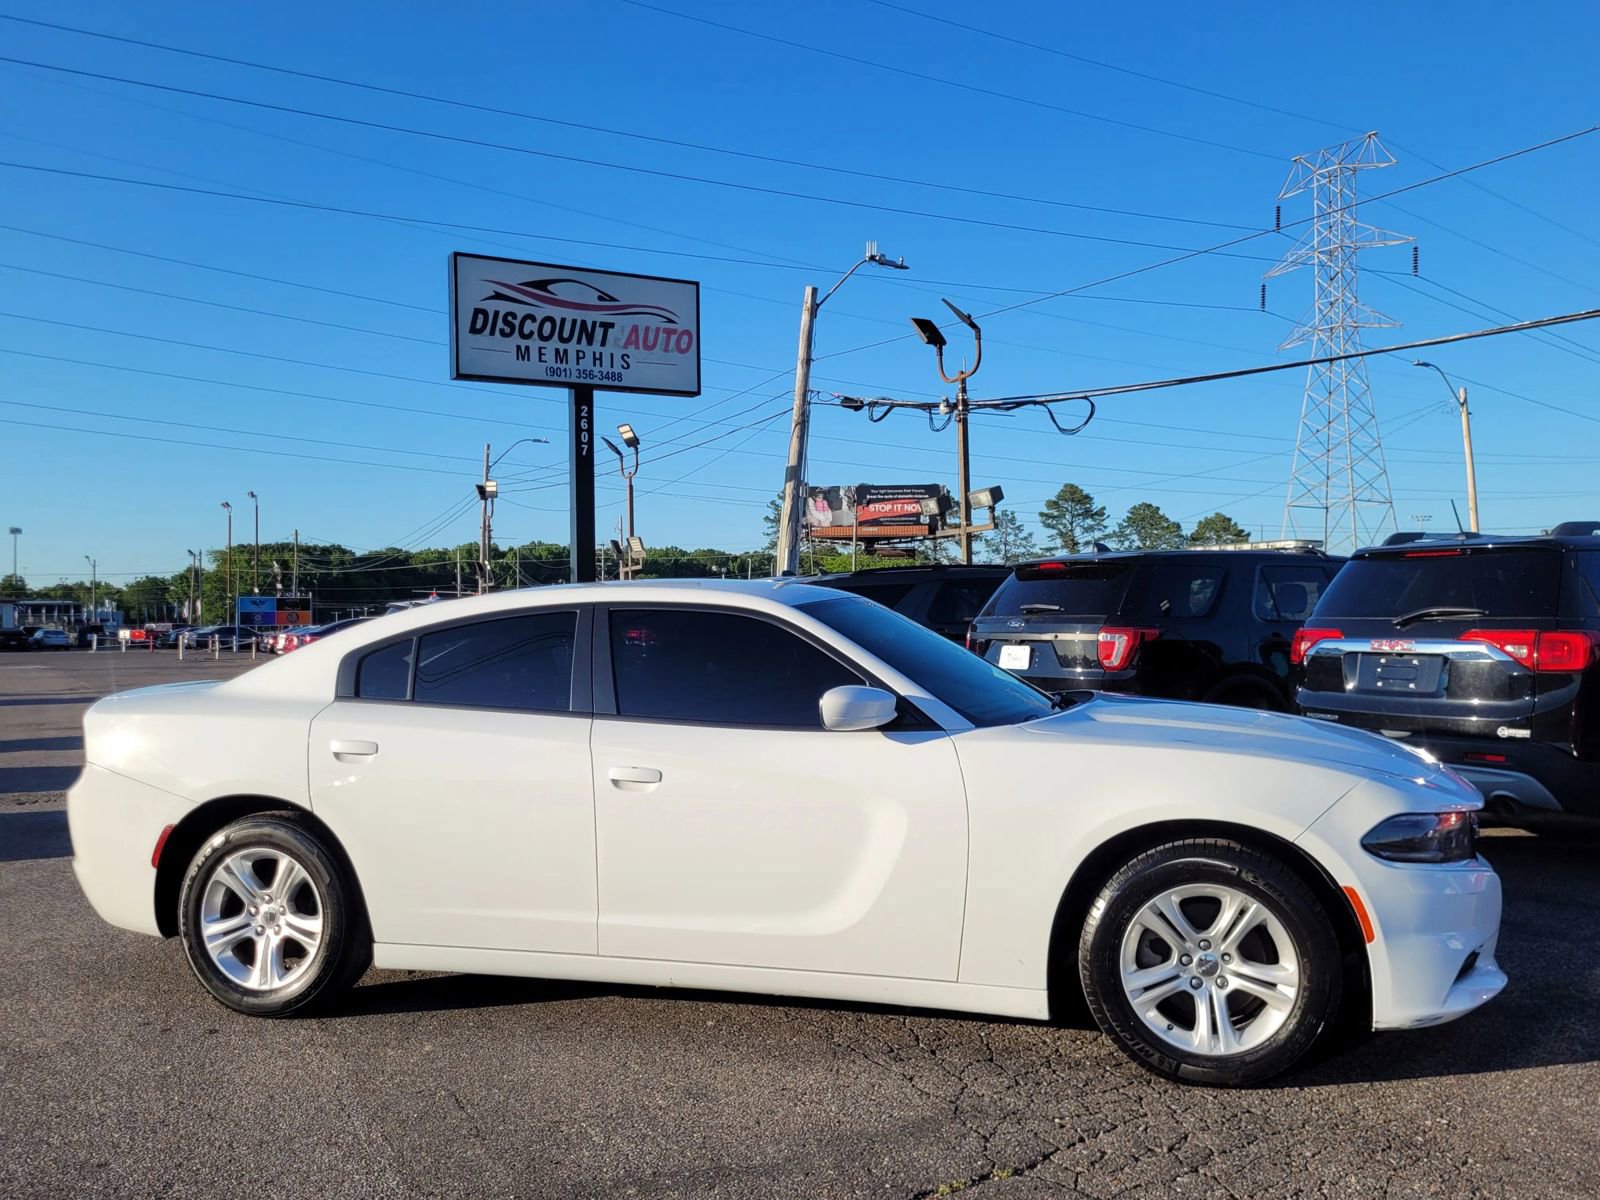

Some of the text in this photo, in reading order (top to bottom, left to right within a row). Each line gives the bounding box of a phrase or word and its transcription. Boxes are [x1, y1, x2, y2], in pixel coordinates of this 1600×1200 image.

[468, 307, 694, 355] DISCOUNT AUTO
[515, 344, 631, 370] MEMPHIS
[545, 366, 623, 382] (901) 356-3488
[580, 405, 589, 456] 2607
[869, 504, 892, 512] STOP
[894, 503, 902, 512] IT
